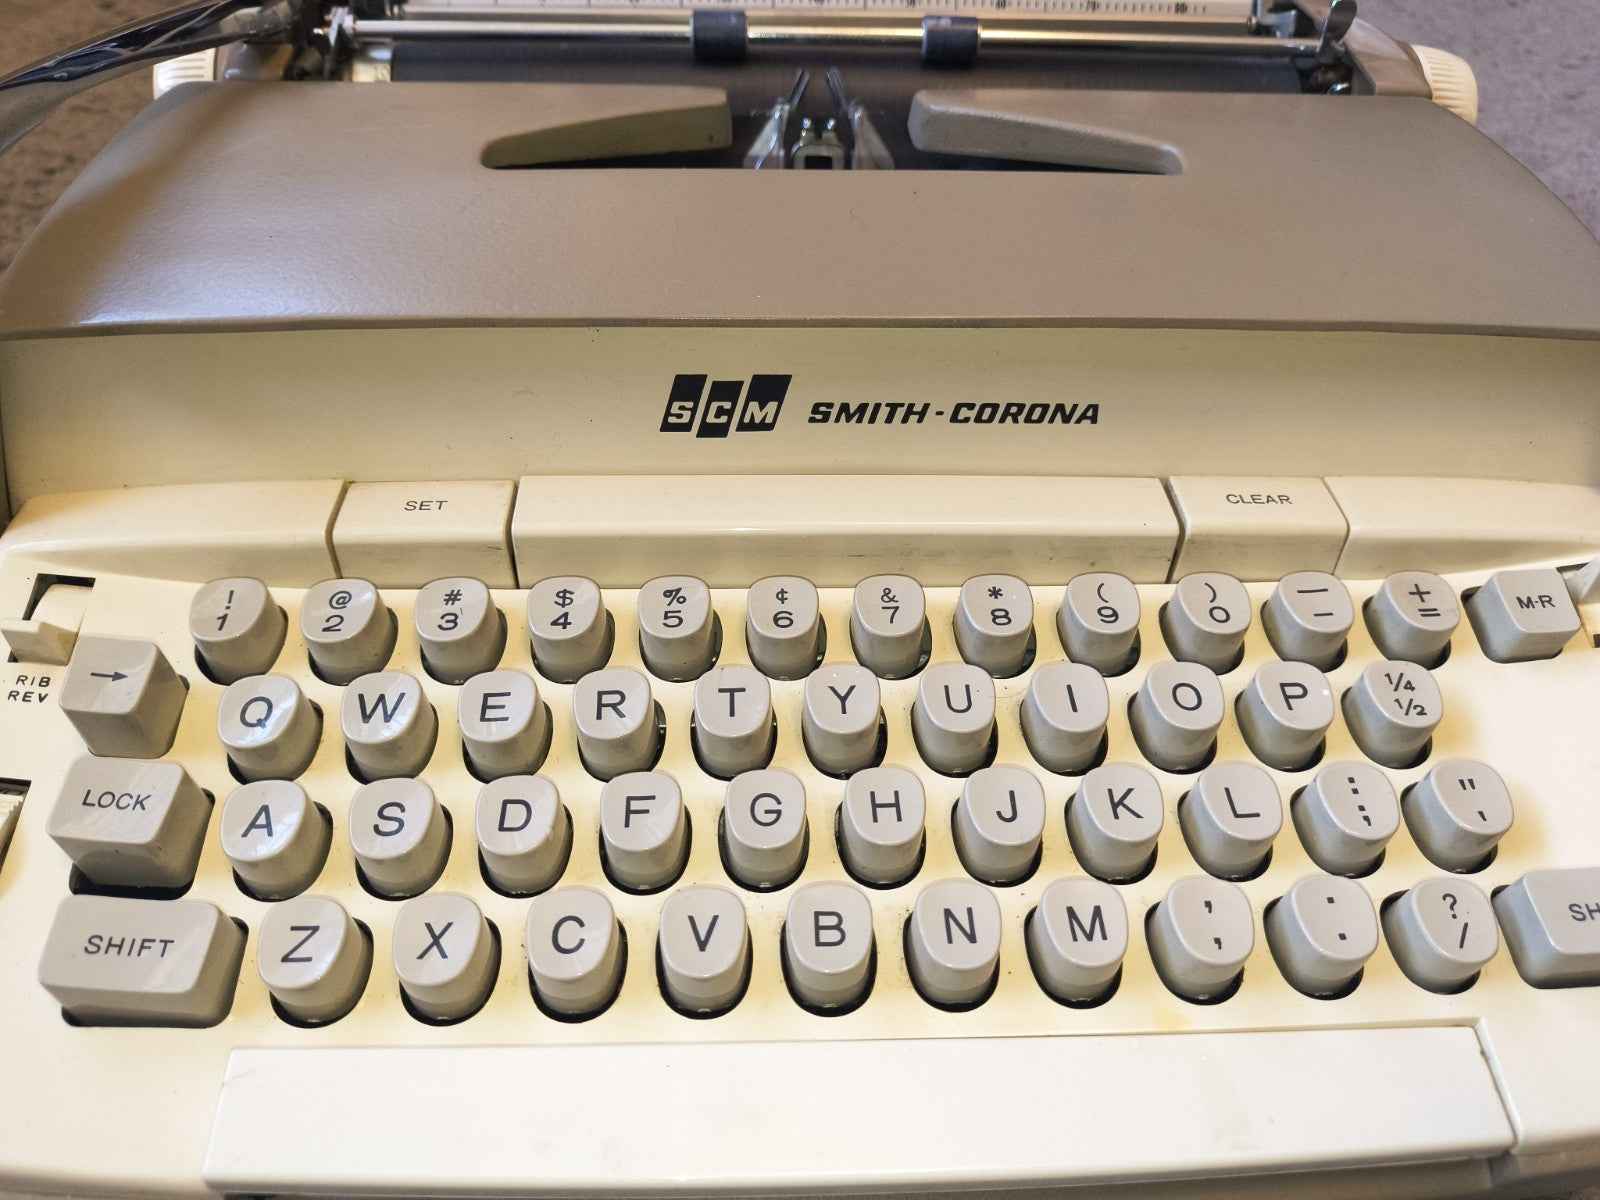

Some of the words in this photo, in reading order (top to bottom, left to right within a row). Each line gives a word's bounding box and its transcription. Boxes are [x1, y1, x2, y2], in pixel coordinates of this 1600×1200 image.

[667, 400, 779, 425] SCM
[403, 500, 449, 512] SET
[1225, 493, 1293, 505] CLEAR
[224, 589, 235, 611] !
[328, 590, 353, 611] @
[442, 588, 463, 607] #
[553, 588, 575, 609] $
[662, 586, 688, 607] %
[775, 587, 789, 605] ¢
[880, 587, 900, 604] &
[1096, 582, 1110, 604] (
[1204, 582, 1217, 604] )
[1407, 583, 1432, 604] +
[216, 612, 229, 632] 1
[321, 614, 345, 633] 2
[437, 612, 460, 632] 3
[549, 611, 573, 630] 4
[661, 609, 684, 629] 5
[772, 610, 794, 629] 6
[880, 605, 900, 625] 7
[990, 607, 1013, 627] 8
[1096, 605, 1120, 624] 9
[1208, 605, 1231, 624] 0
[1417, 607, 1442, 618] =
[15, 674, 52, 688] RIB
[7, 689, 49, 704] REV
[357, 692, 407, 725] W
[479, 691, 512, 723] E
[595, 689, 627, 721] R
[717, 687, 747, 718] T
[827, 684, 857, 715] Y
[943, 683, 973, 714] U
[1066, 683, 1079, 713] I
[1171, 682, 1203, 712] O
[1279, 681, 1309, 711] P
[239, 695, 274, 729] Q
[81, 788, 152, 811] LOCK
[623, 794, 657, 829] F
[749, 792, 783, 828] G
[869, 789, 903, 824] H
[995, 789, 1018, 824] J
[1106, 787, 1145, 821] K
[1223, 786, 1261, 819] L
[240, 804, 274, 839] A
[372, 801, 406, 838] S
[497, 798, 533, 833] D
[1441, 892, 1458, 920] ?
[551, 914, 586, 955] C
[687, 914, 720, 953] V
[813, 910, 847, 948] B
[943, 906, 978, 945] N
[1065, 904, 1109, 943] M
[1458, 921, 1469, 950] /
[83, 934, 175, 958] SHIFT
[279, 924, 321, 964] Z
[415, 921, 454, 961] X
